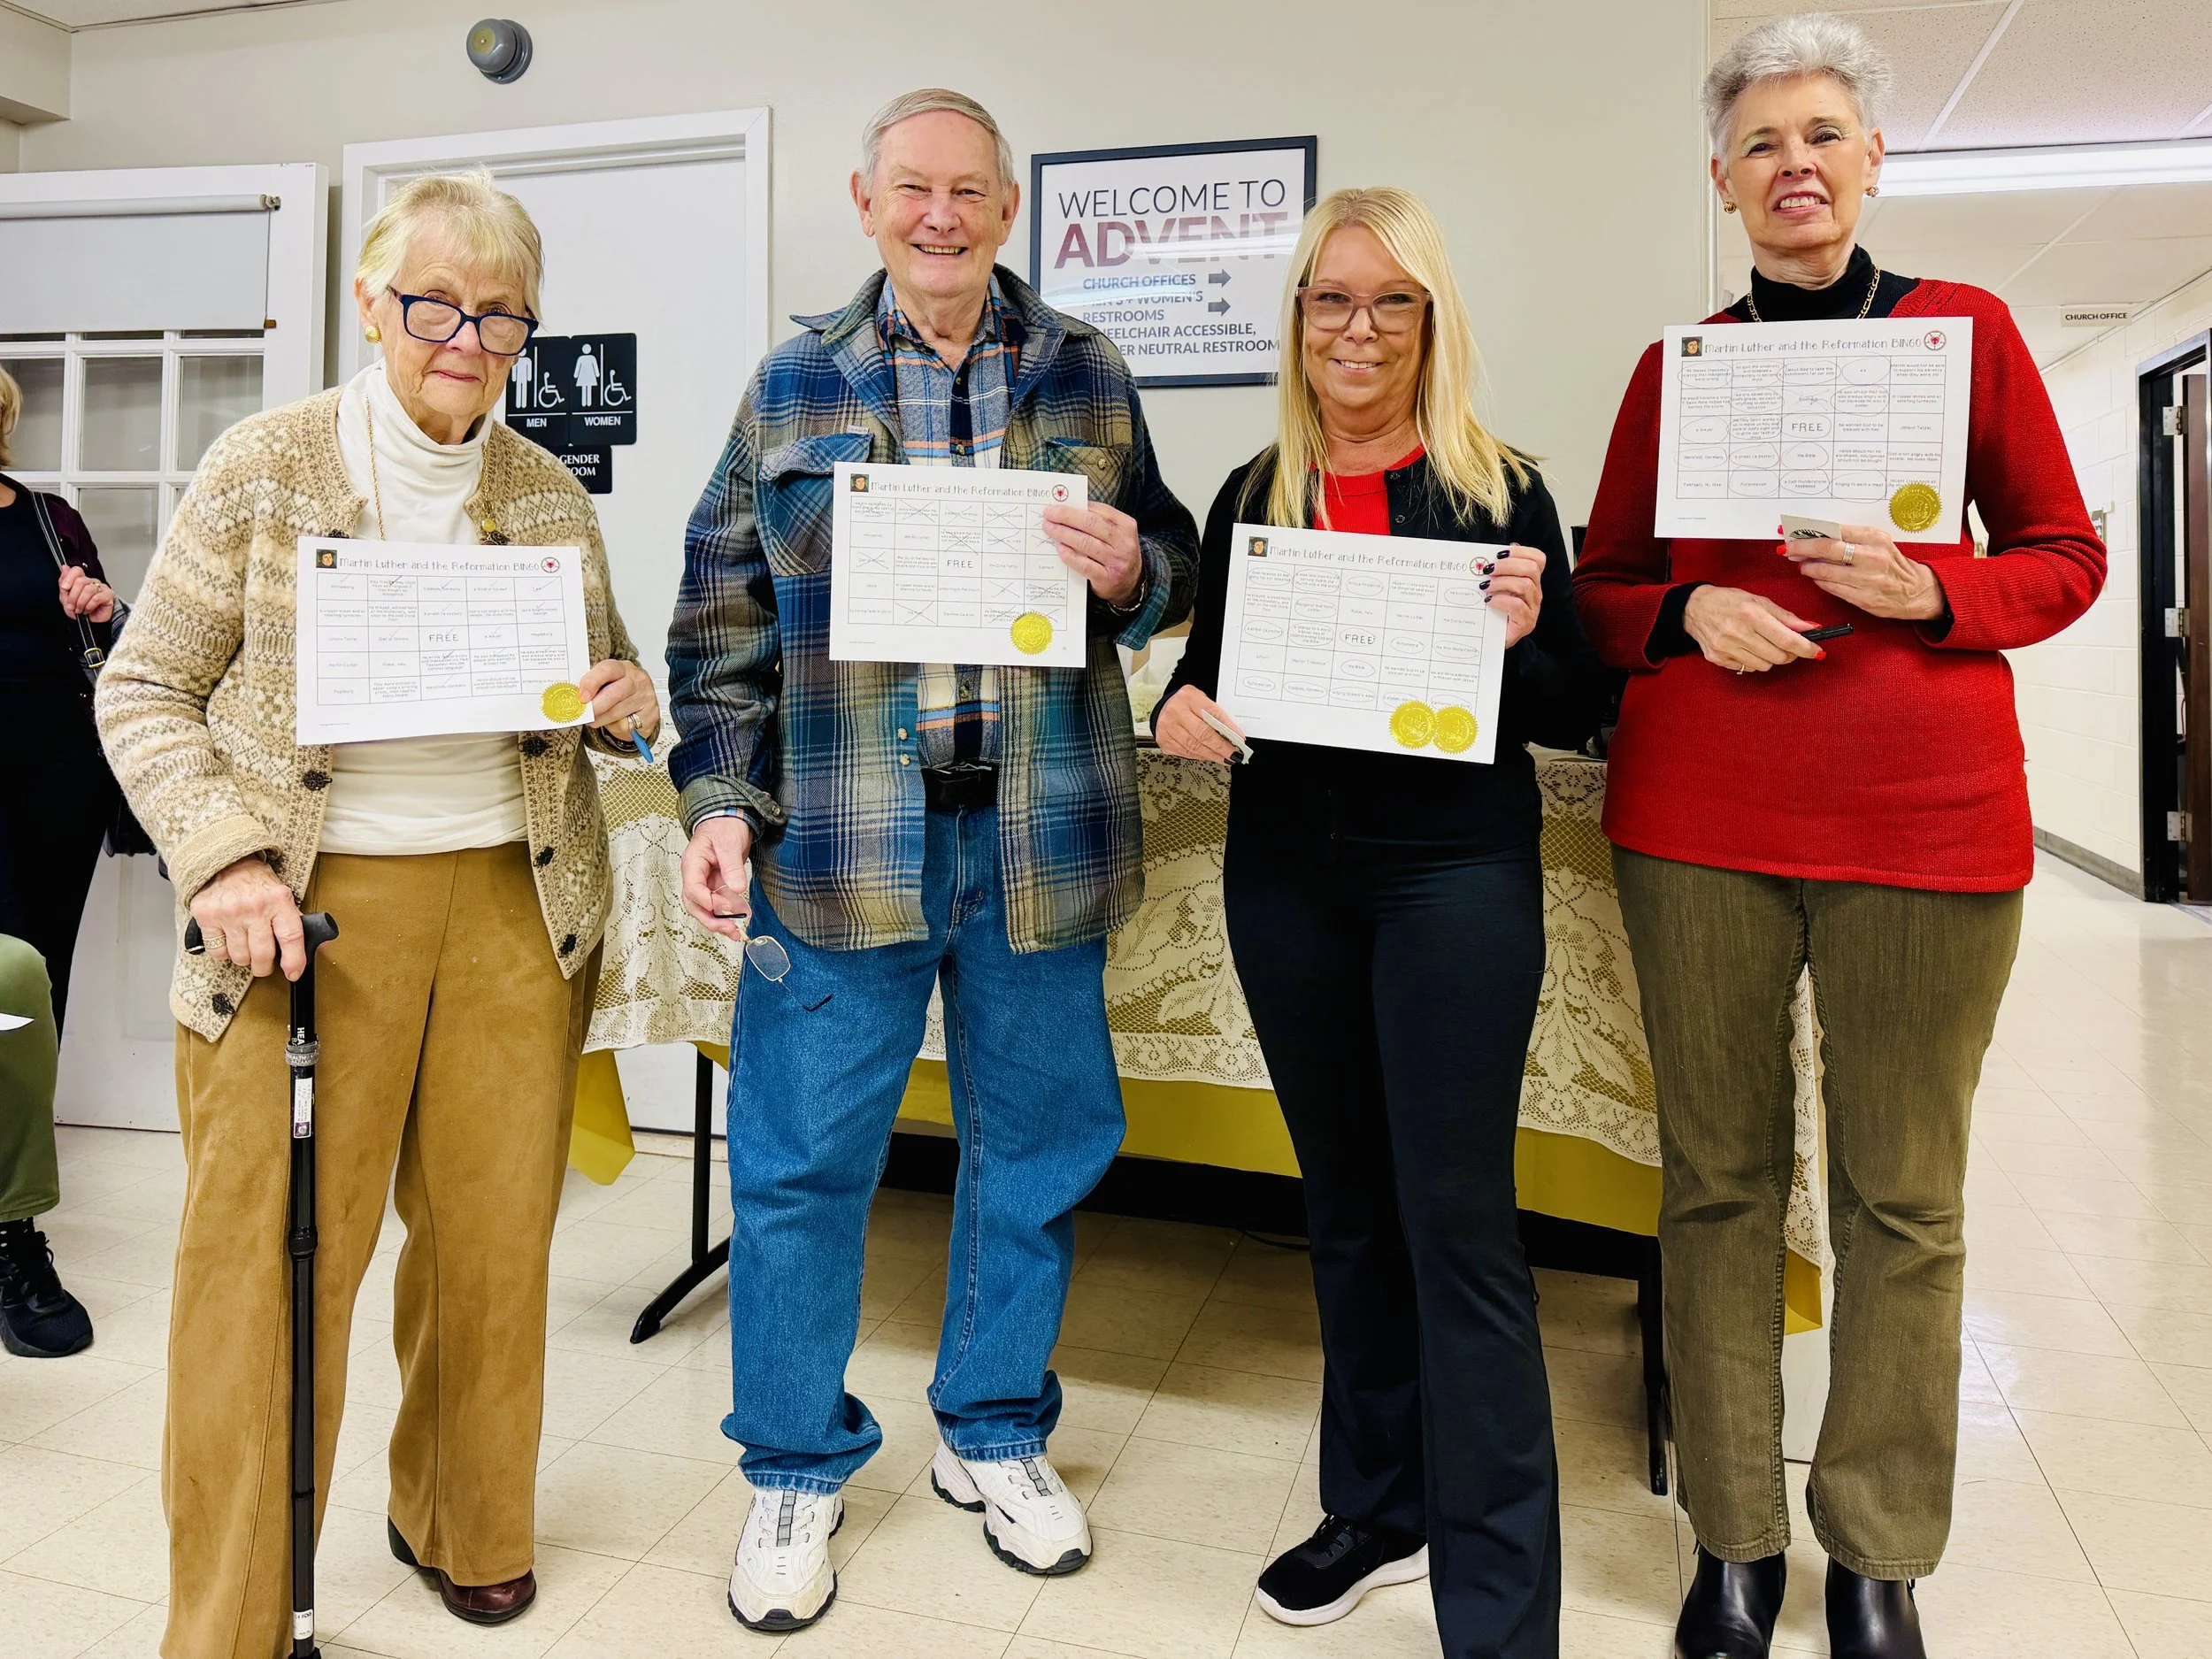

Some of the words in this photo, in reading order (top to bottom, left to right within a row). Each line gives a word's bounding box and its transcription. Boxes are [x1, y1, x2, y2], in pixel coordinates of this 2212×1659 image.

[1058, 182, 1230, 219] WELCOME
[1239, 179, 1286, 209] TO
[1054, 211, 1288, 269] ADVENT
[1083, 276, 1139, 289] CHURCH
[1142, 274, 1196, 287] OFFICES
[1083, 309, 1164, 323] RESTROOMS
[1103, 326, 1170, 339] EELCHAIR
[1173, 323, 1256, 337] ACCESSIBLE,
[1139, 342, 1200, 355] NEUTRAL
[1202, 340, 1279, 353] RESTROOM
[1704, 341, 1739, 354] Martin
[1741, 342, 1775, 353] Luther
[1778, 342, 1798, 351] and
[1801, 340, 1818, 350] the
[1822, 338, 1888, 350] Reformation
[1891, 337, 1922, 349] BINGO
[526, 418, 547, 427] MEN
[584, 416, 621, 426] WOMEN
[1792, 422, 1824, 433] FREE
[559, 454, 600, 465] GENDER
[567, 466, 596, 476] OOM
[871, 480, 901, 492] Martin
[902, 482, 932, 494] Luther
[934, 485, 950, 494] and
[953, 485, 968, 495] the
[971, 486, 1024, 497] Reformation
[1026, 488, 1051, 498] BINGO
[340, 557, 373, 569] Martin
[375, 559, 408, 570] Luther
[411, 560, 429, 570] and
[432, 560, 449, 571] the
[451, 561, 511, 572] Reformation
[513, 562, 540, 572] BINGO
[947, 559, 973, 569] FREE
[1270, 545, 1301, 558] Martin
[1303, 548, 1334, 561] Luther
[1338, 551, 1356, 563] and
[1358, 552, 1374, 565] the
[1378, 555, 1437, 570] Reformation
[1440, 560, 1468, 572] BINGO
[428, 634, 459, 642] FREE
[1344, 634, 1375, 645] FREE
